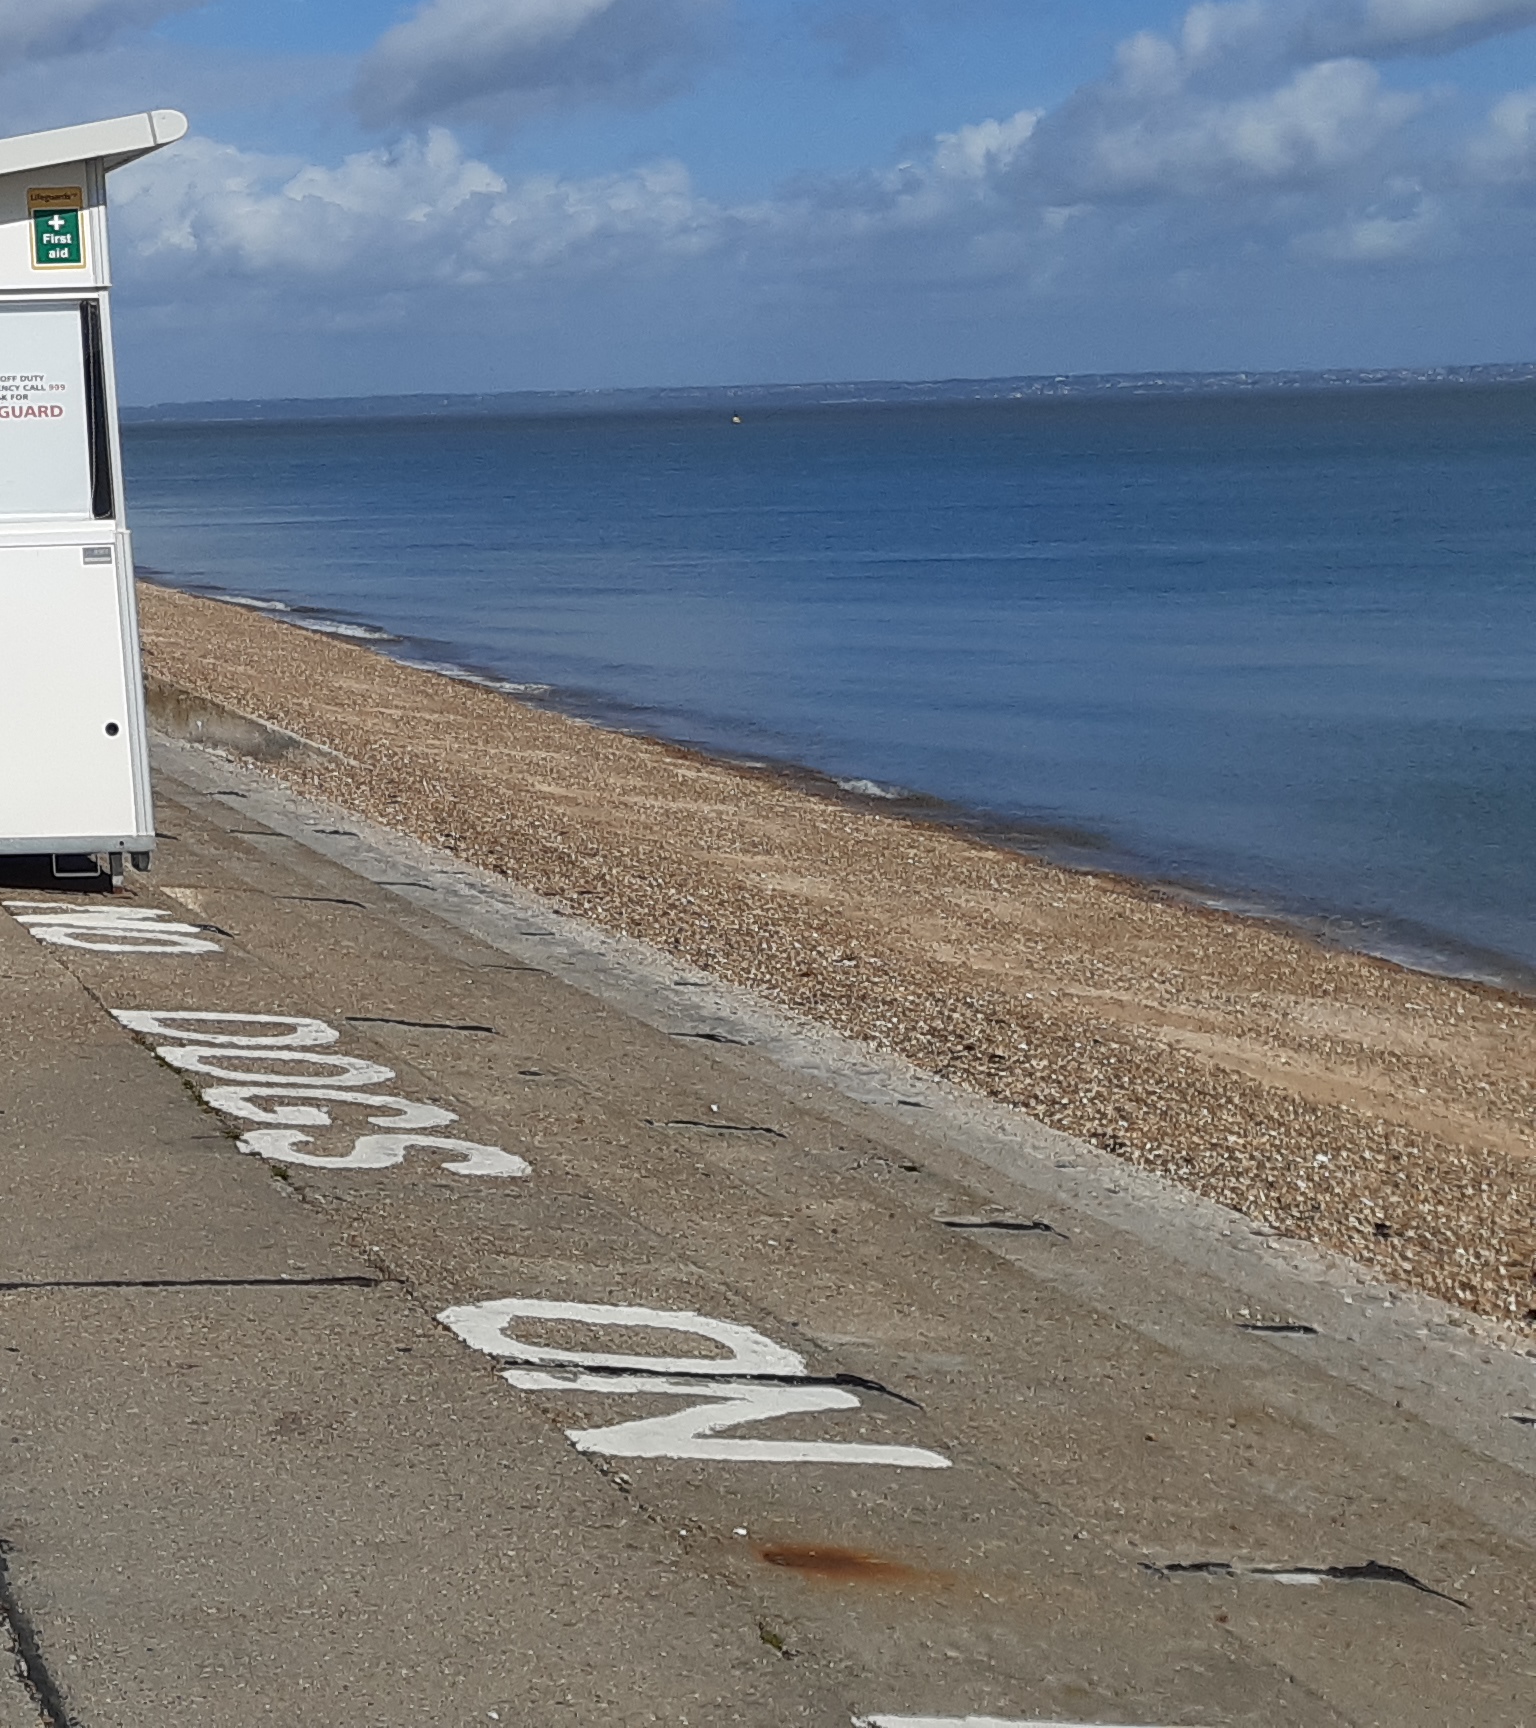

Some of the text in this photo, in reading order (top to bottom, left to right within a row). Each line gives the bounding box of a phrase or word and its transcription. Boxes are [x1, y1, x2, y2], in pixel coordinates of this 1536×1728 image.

[42, 233, 72, 245] First
[48, 248, 69, 259] aid
[0, 375, 18, 383] OFF
[19, 374, 45, 383] DUTY
[23, 384, 46, 392] CALL
[10, 393, 29, 401] FOR
[110, 1008, 532, 1177] DOGS
